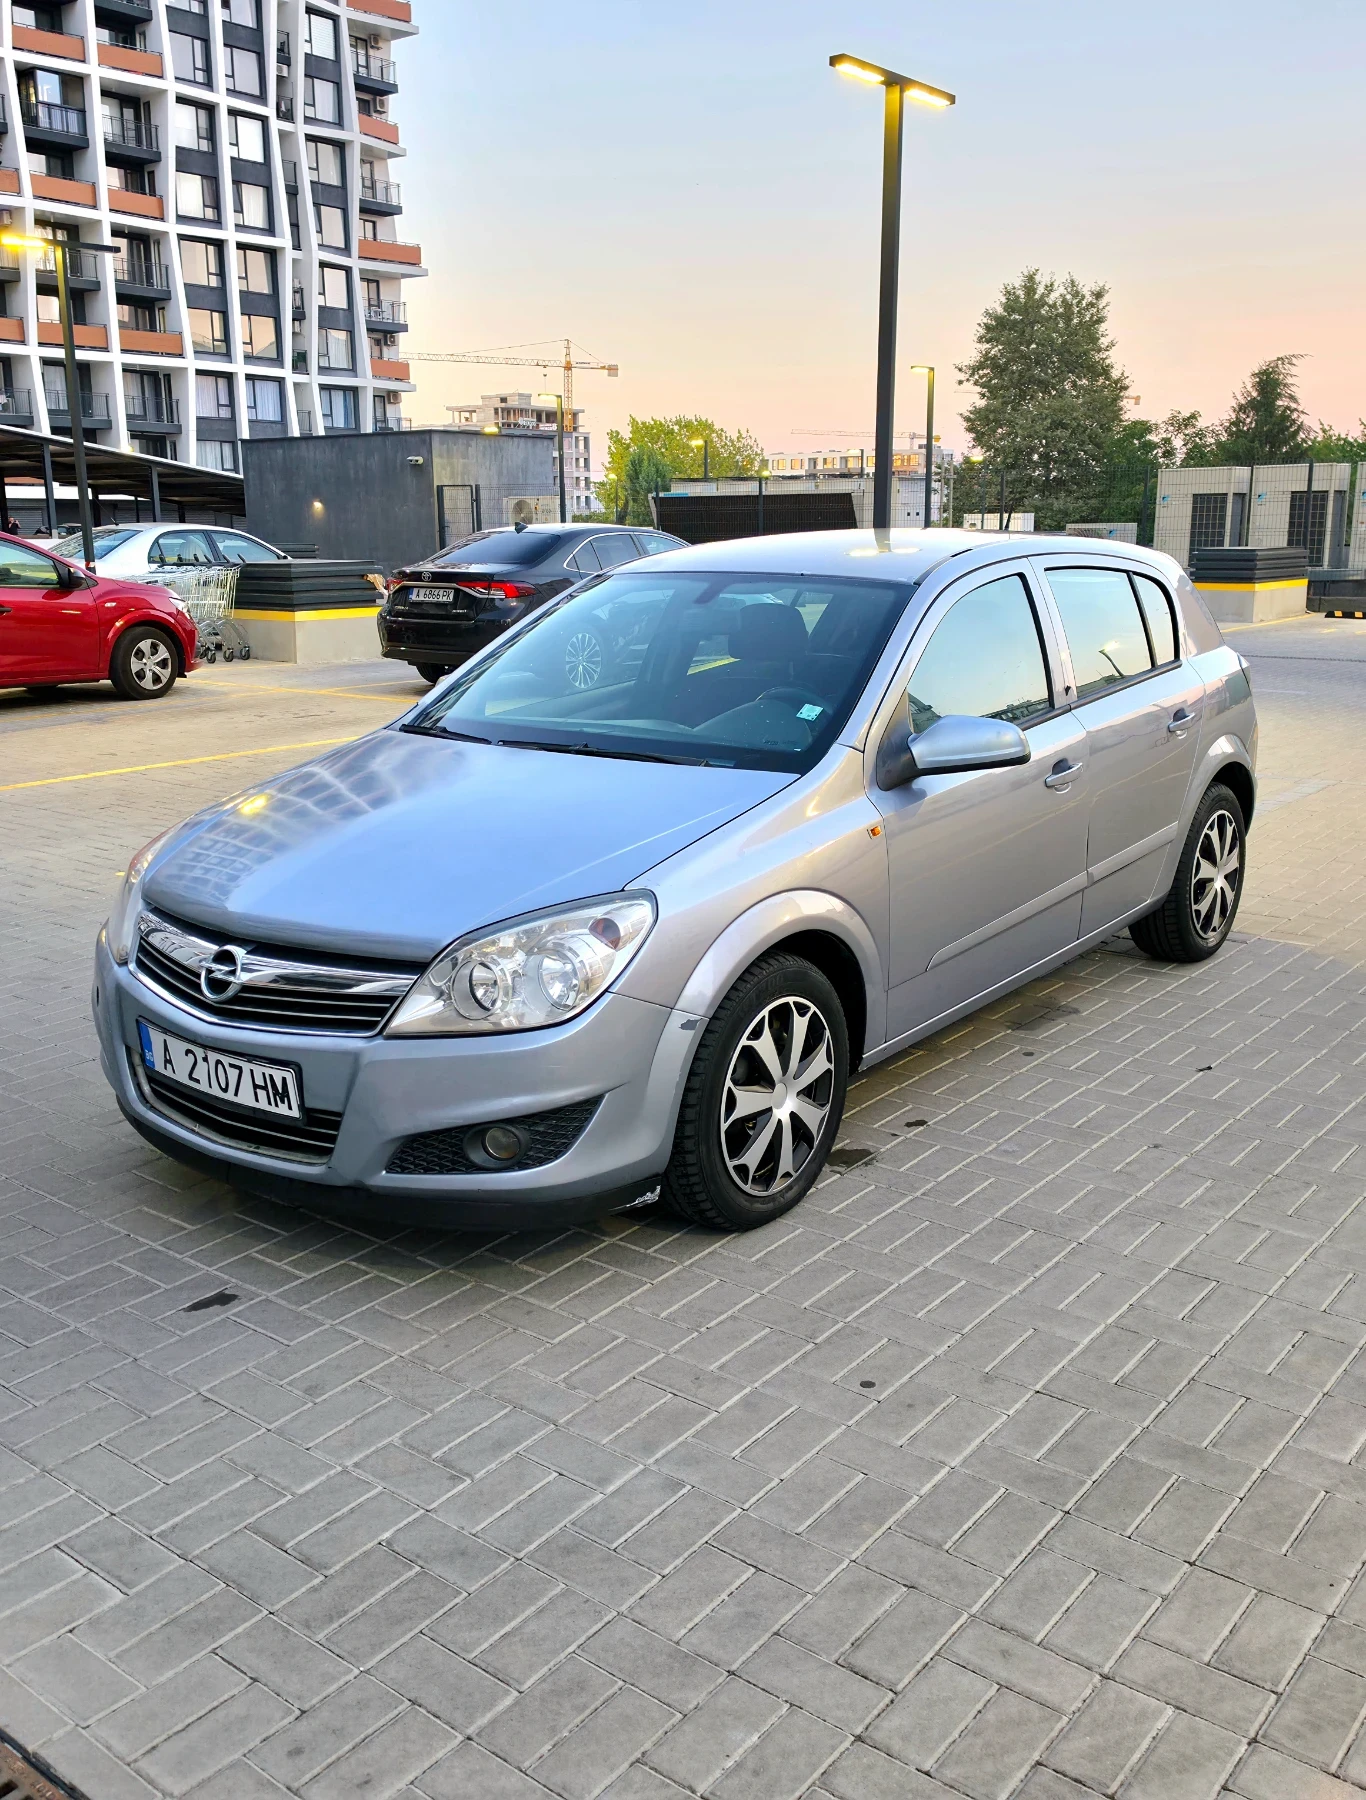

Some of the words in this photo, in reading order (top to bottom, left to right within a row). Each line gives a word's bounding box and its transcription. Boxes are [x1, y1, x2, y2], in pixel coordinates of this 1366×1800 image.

[415, 589, 420, 599] A
[423, 589, 441, 600] 6866
[442, 590, 453, 600] PK
[163, 1038, 176, 1075] A
[184, 1048, 244, 1098] 2107
[250, 1068, 293, 1112] HM
